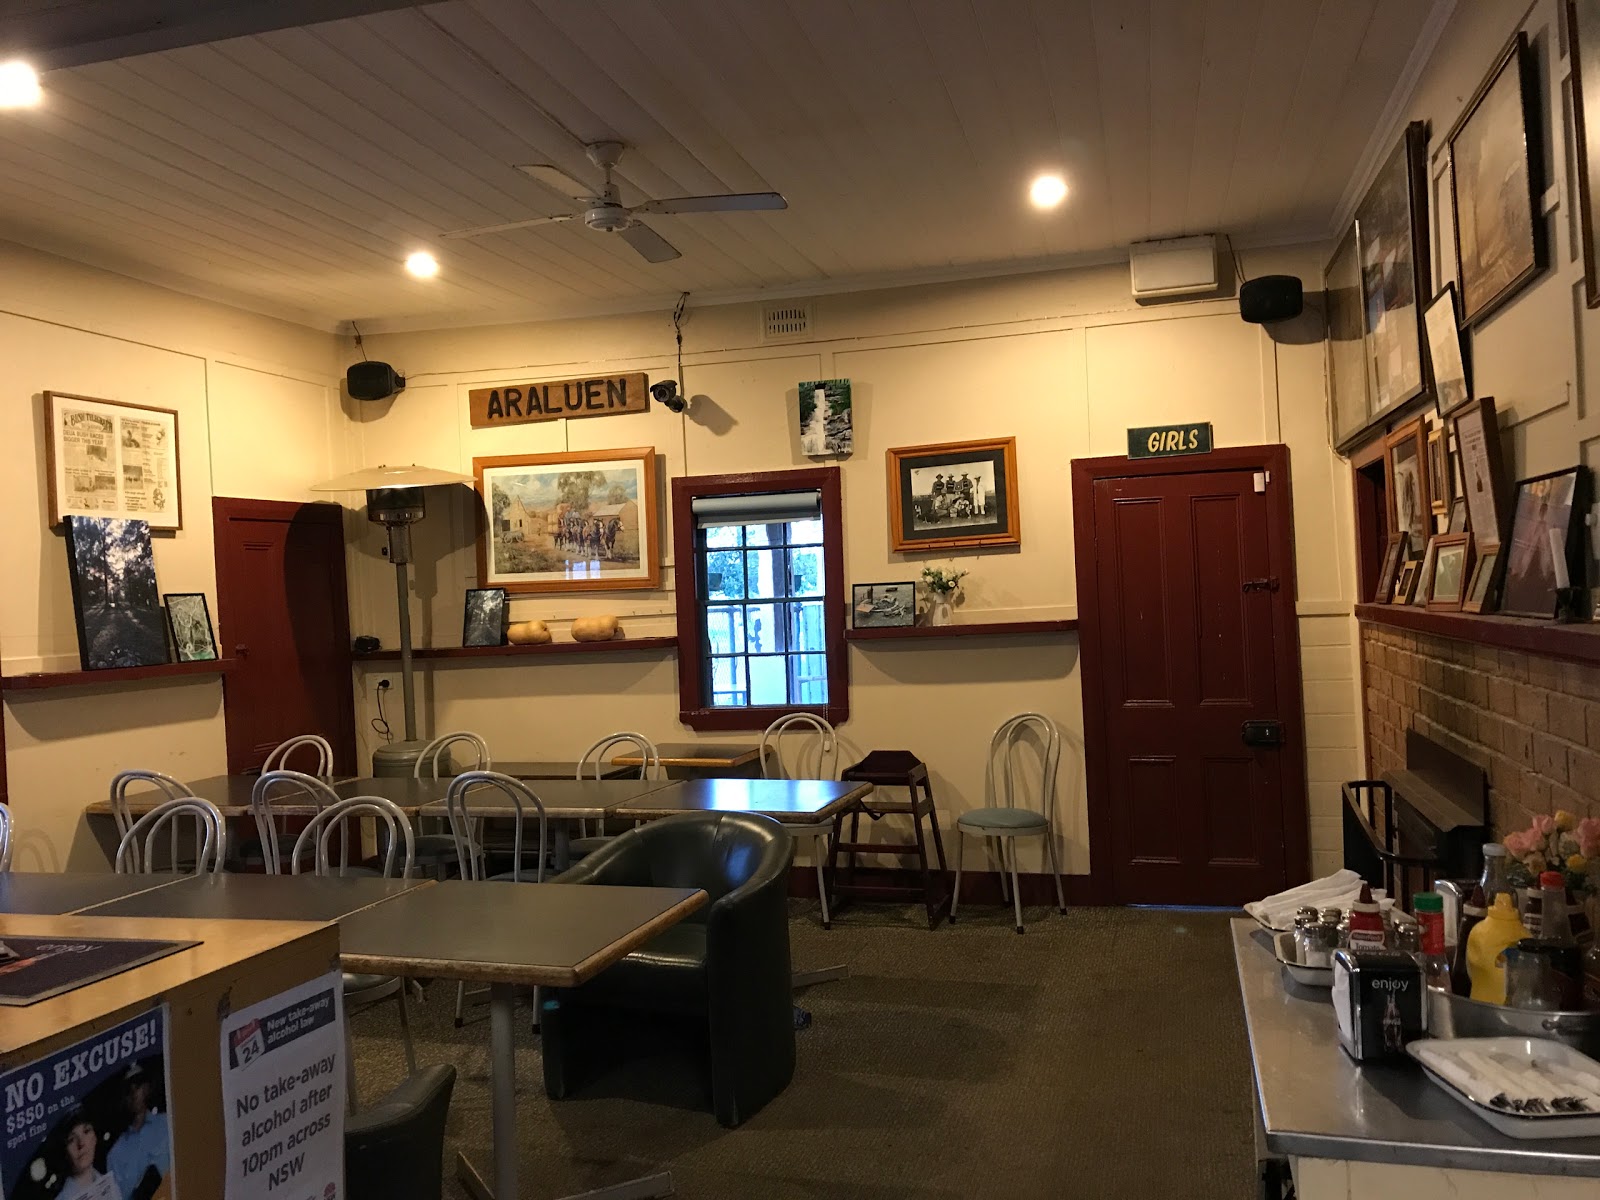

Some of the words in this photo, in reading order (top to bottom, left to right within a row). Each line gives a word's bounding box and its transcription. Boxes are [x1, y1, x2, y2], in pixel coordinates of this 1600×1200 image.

[487, 378, 627, 419] ARALUEN
[1147, 429, 1199, 453] GIRLS
[1372, 977, 1409, 992] enjoy
[266, 1014, 287, 1031] New
[287, 997, 330, 1020] take-away
[267, 1022, 299, 1044] alcohol
[301, 1016, 315, 1029] law
[4, 1072, 44, 1113] NO
[53, 1019, 157, 1091] EXCUSE!
[242, 1040, 260, 1064] 24
[237, 1095, 260, 1119] No
[264, 1054, 336, 1103] take-away
[6, 1102, 45, 1134] $550
[48, 1103, 59, 1114] on
[60, 1094, 76, 1108] the
[242, 1100, 296, 1147] alcohol
[299, 1084, 332, 1114] after
[7, 1131, 27, 1149] spot
[29, 1122, 48, 1138] fine
[242, 1141, 283, 1177] 10pm
[287, 1113, 331, 1150] across
[268, 1152, 305, 1191] NSW
